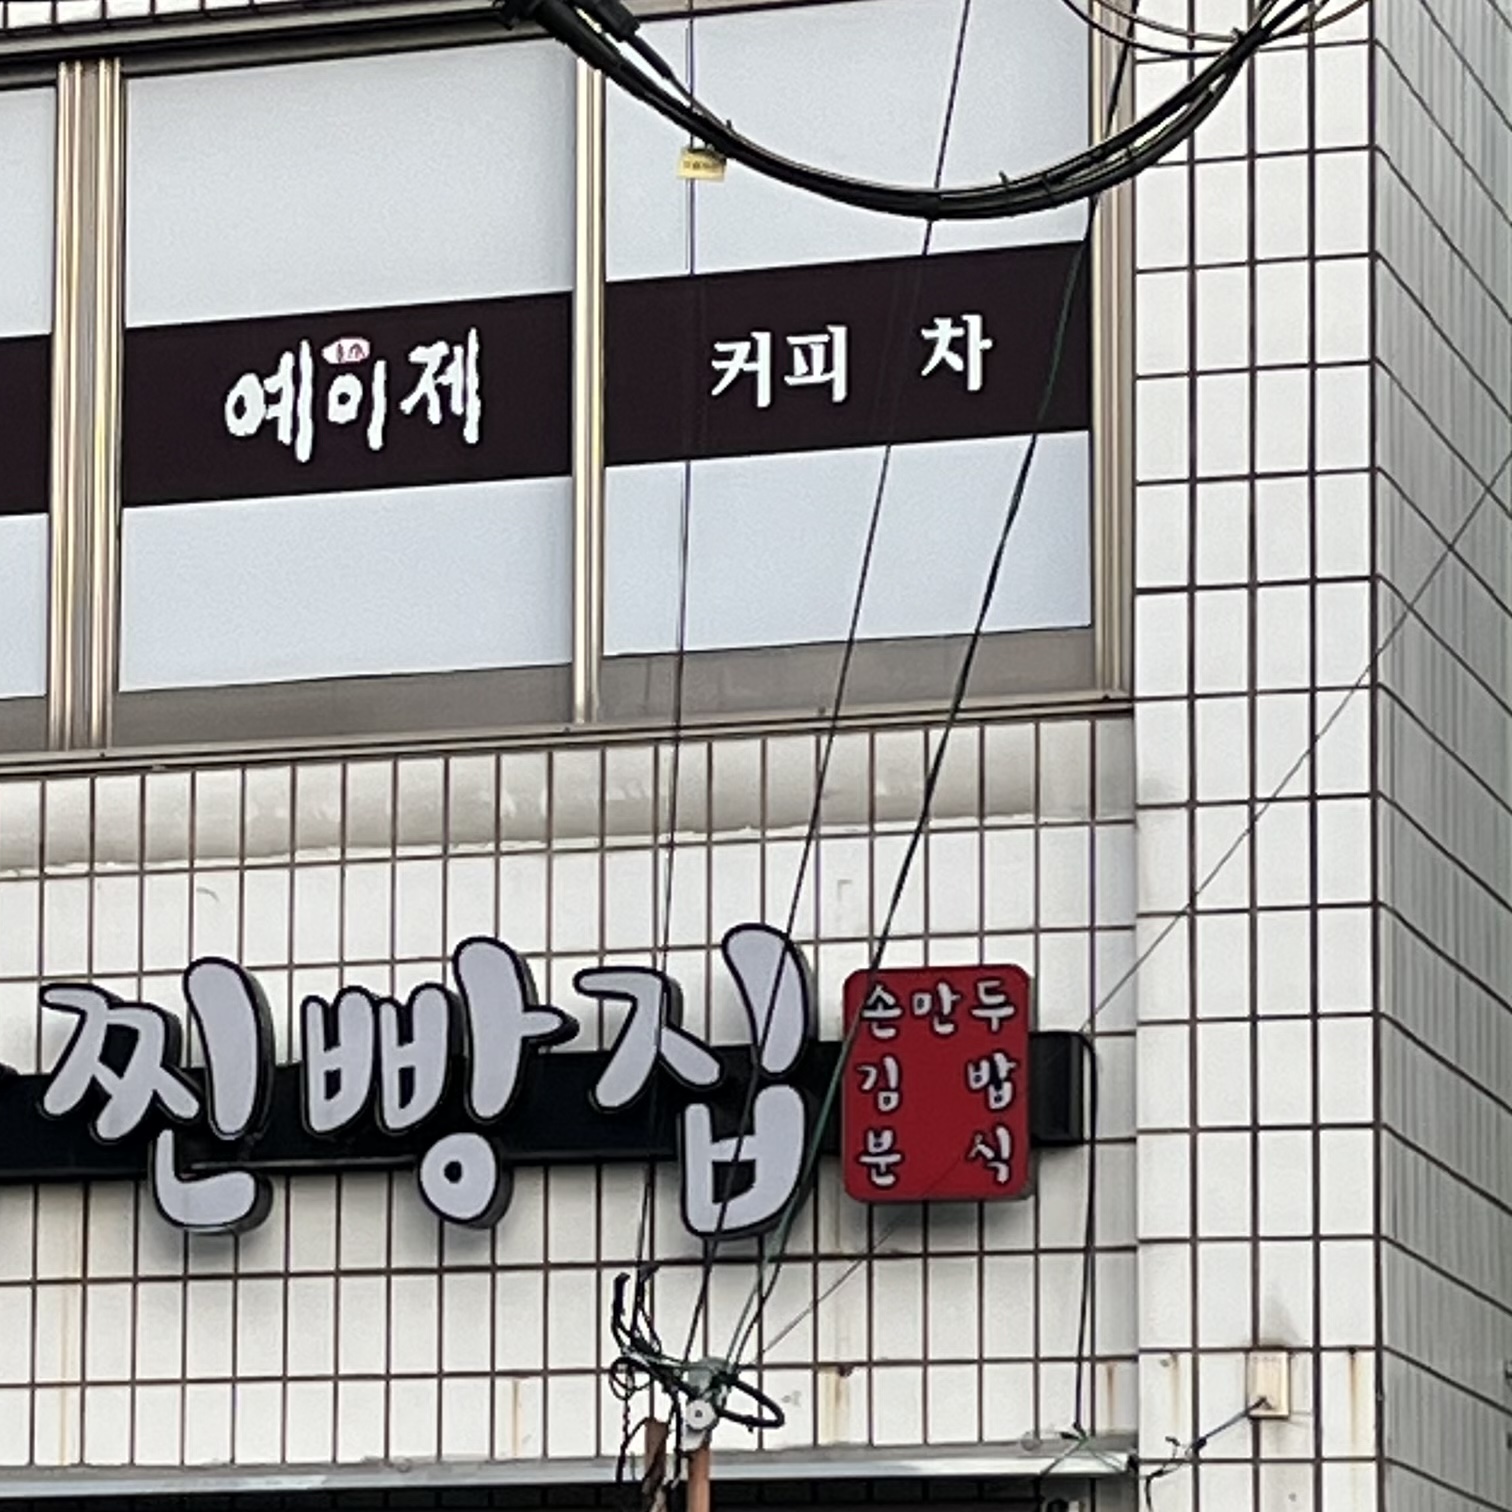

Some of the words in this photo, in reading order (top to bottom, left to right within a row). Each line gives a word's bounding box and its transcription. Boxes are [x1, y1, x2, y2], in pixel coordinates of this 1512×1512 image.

[711, 324, 848, 408] 커피
[920, 313, 993, 391] 차
[224, 328, 482, 463] 예이제
[862, 979, 1016, 1038] 손만두
[856, 1052, 1017, 1111] 김밥
[858, 1125, 1012, 1186] 분식
